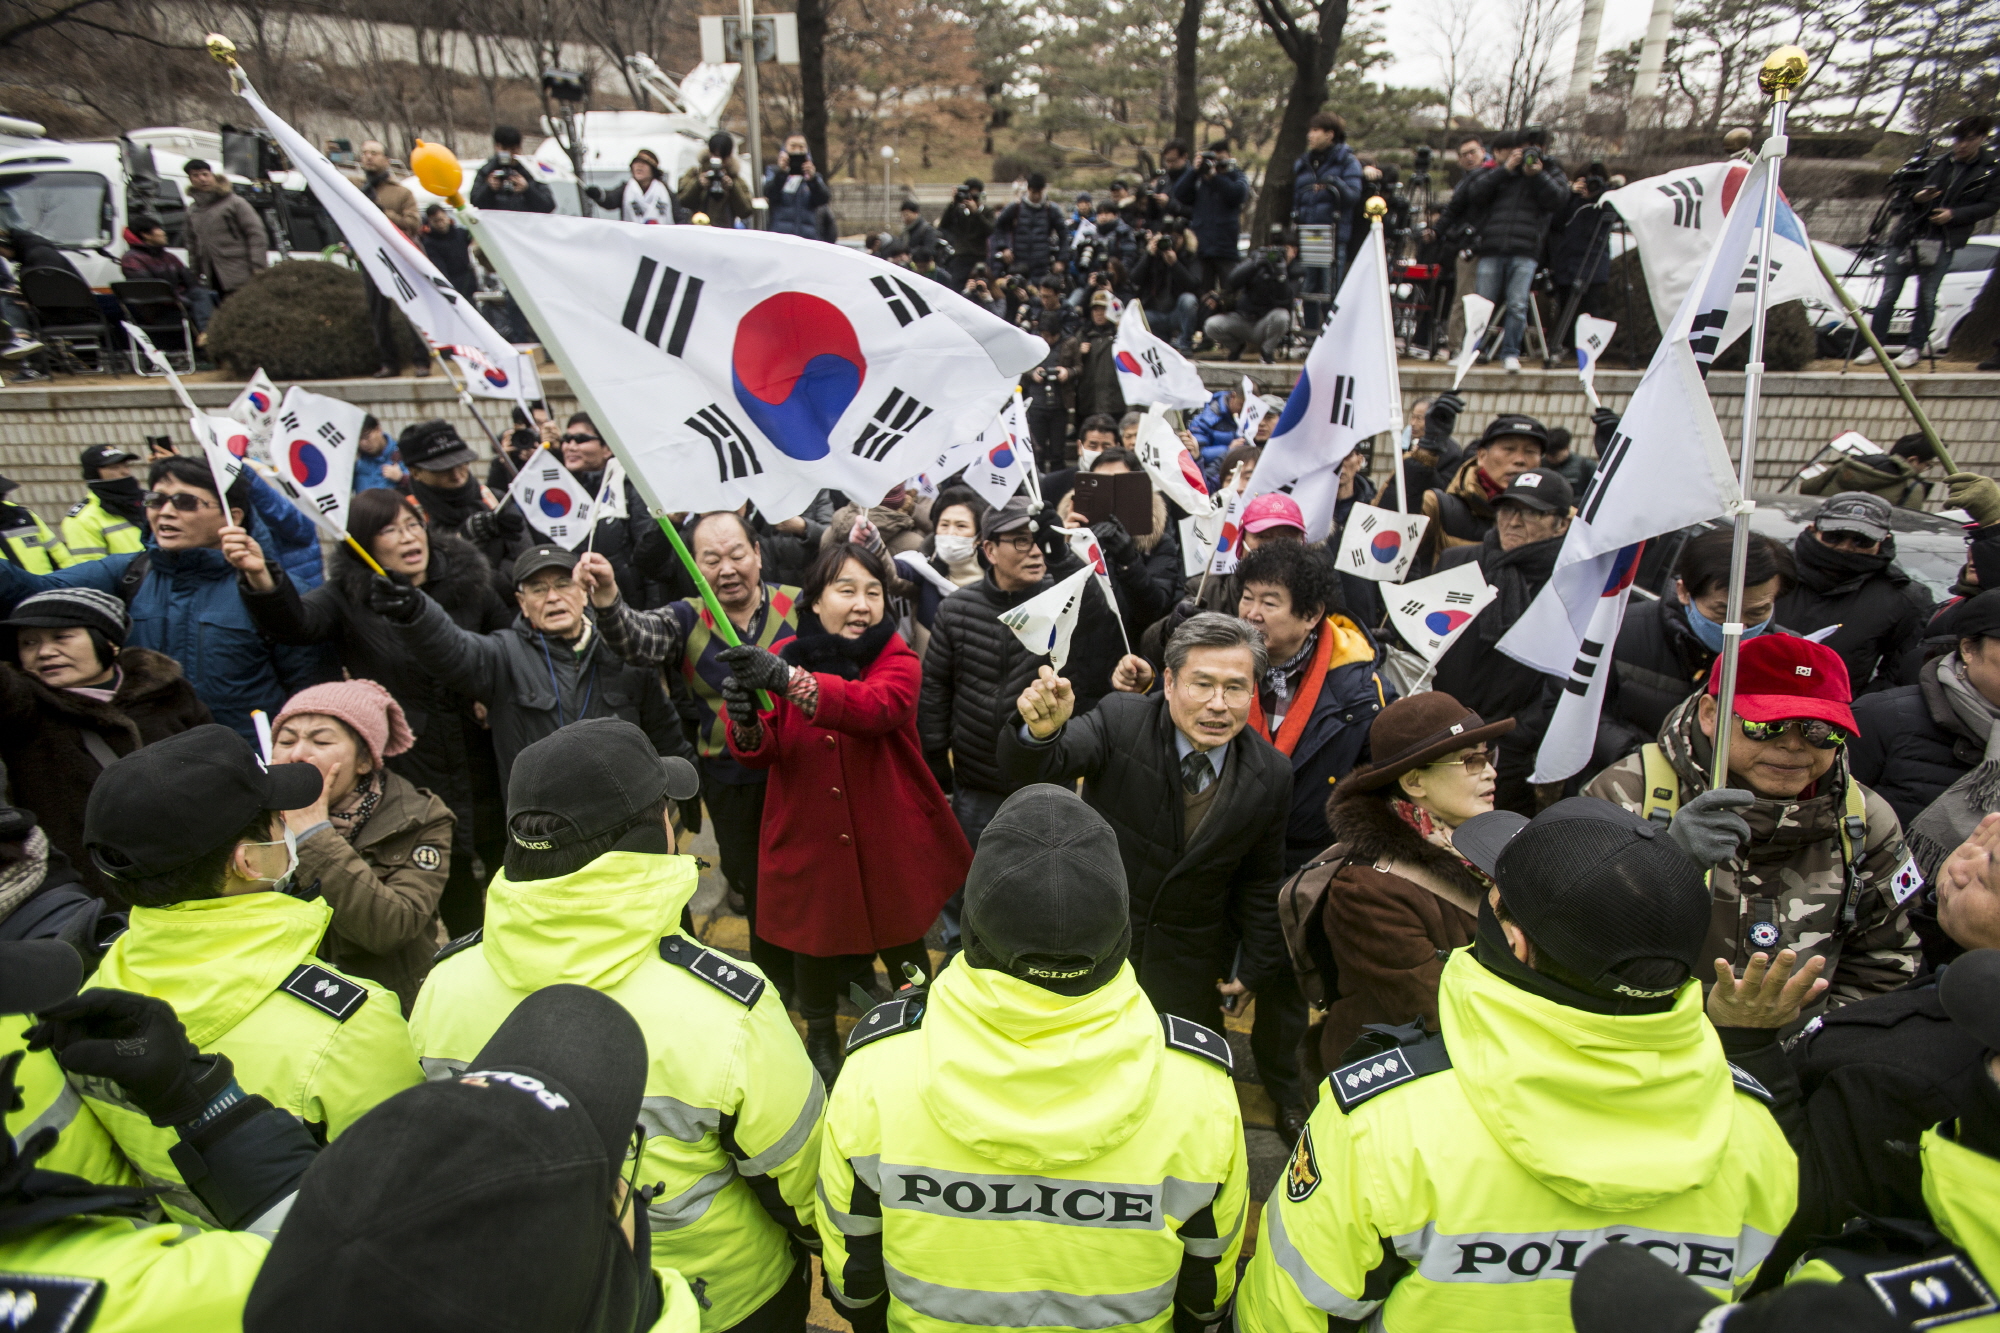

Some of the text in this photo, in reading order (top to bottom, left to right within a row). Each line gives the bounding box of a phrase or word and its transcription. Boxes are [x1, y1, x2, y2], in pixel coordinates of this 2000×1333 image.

[1028, 967, 1089, 978] POLICE
[897, 1174, 1153, 1222] POLICE
[1452, 1233, 1735, 1281] POLCE
